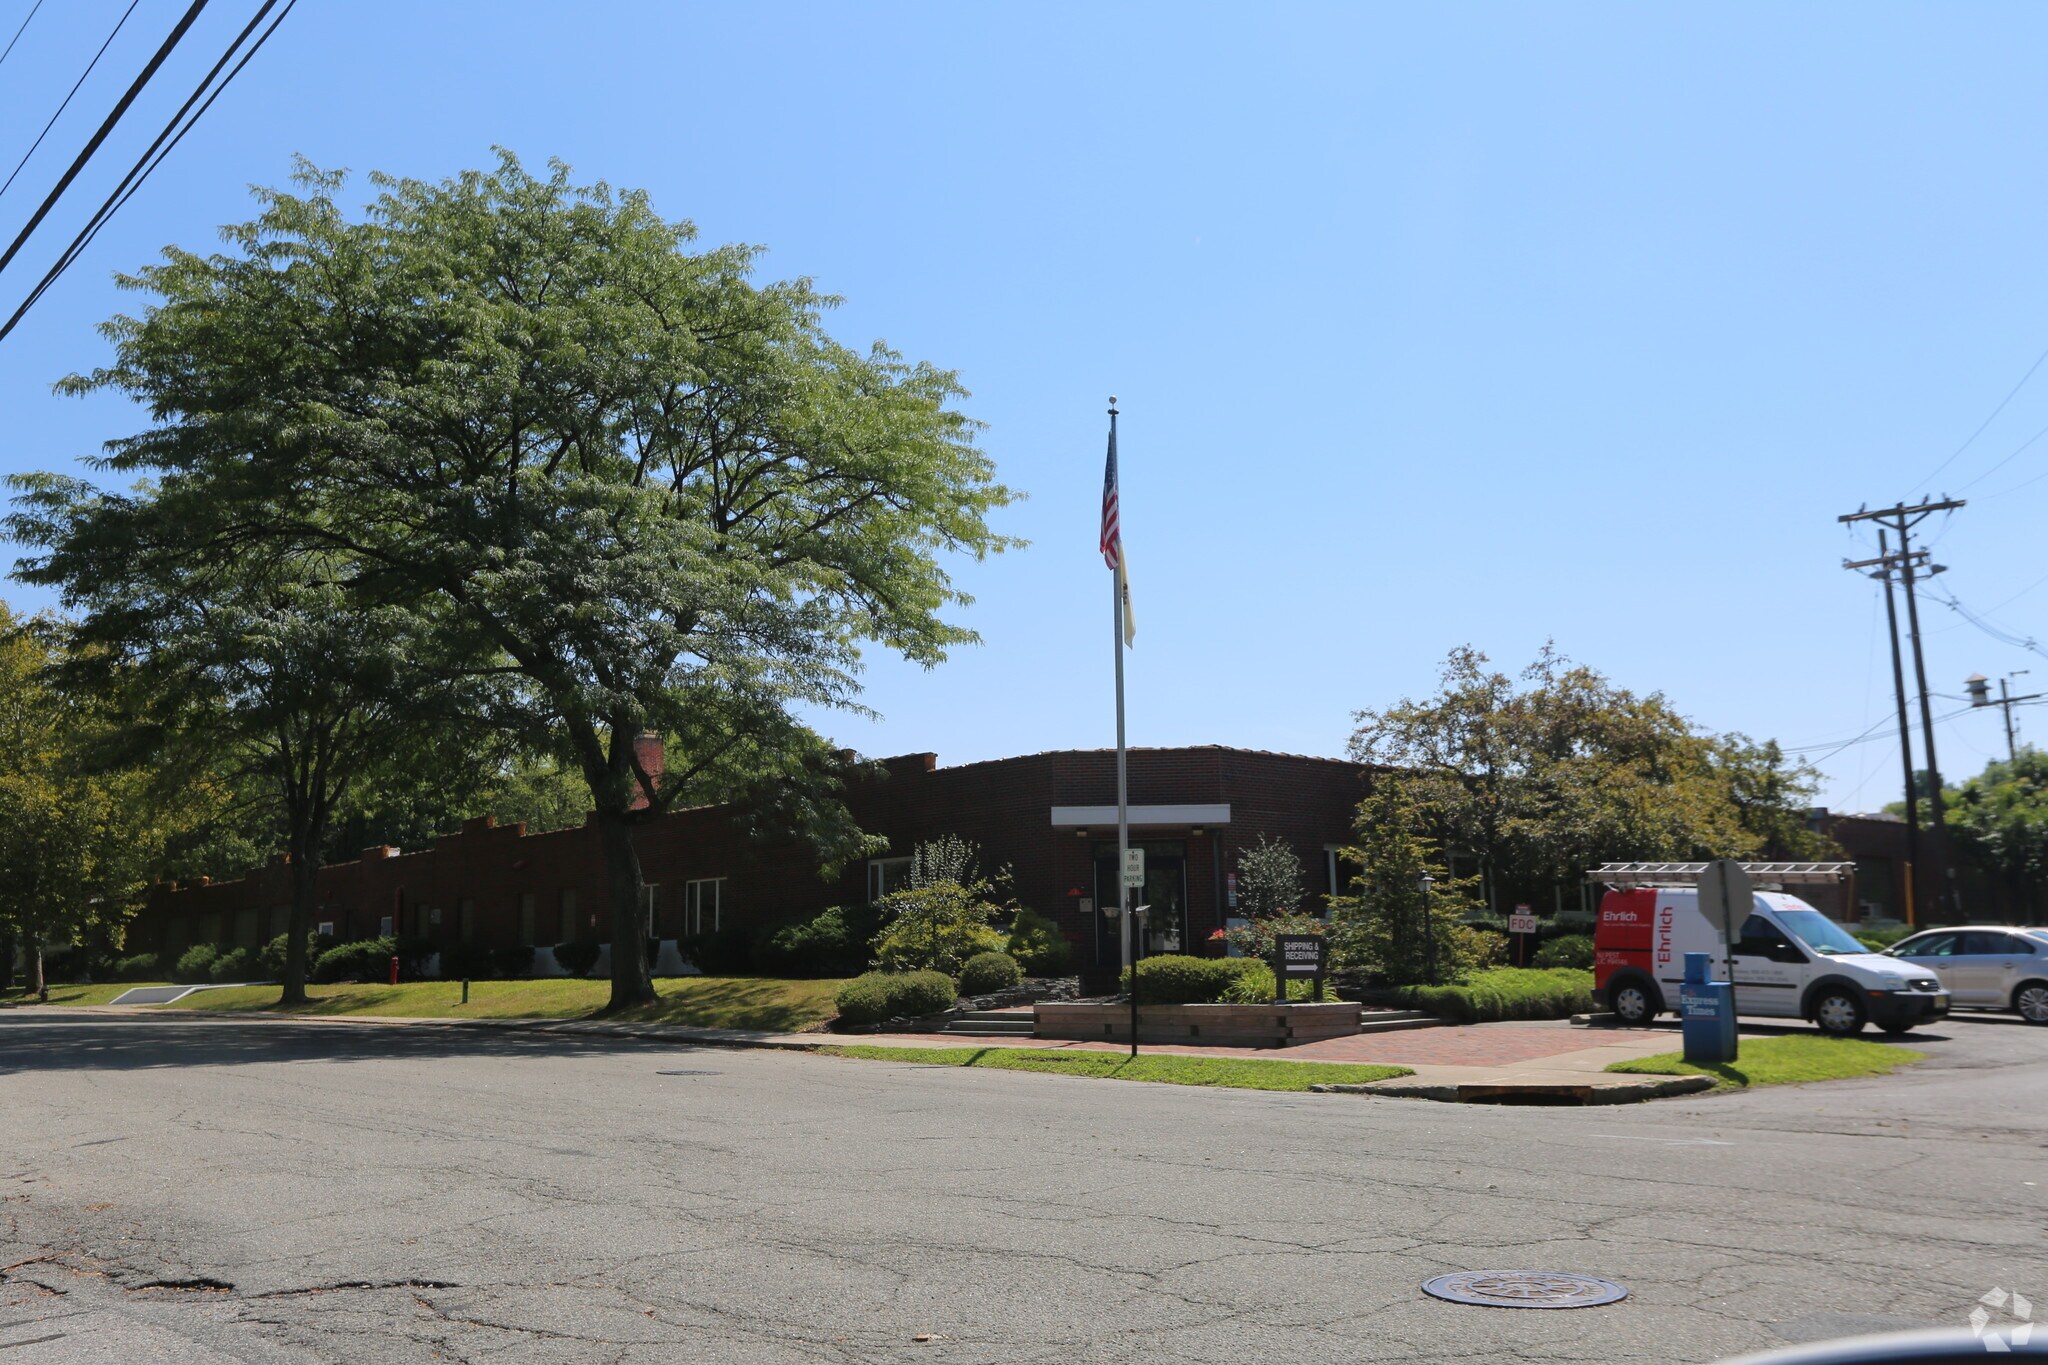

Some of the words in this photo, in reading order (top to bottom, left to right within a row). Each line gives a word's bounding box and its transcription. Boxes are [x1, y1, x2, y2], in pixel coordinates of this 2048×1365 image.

[1603, 911, 1637, 921] Ehrlich
[1511, 919, 1533, 930] FDC
[1658, 906, 1673, 962] Ehrlich
[1284, 942, 1313, 951] SHIPPING
[1314, 942, 1319, 951] &
[1285, 951, 1319, 960] RECEIVING
[1681, 995, 1719, 1007] Express
[1686, 1005, 1716, 1016] Times
